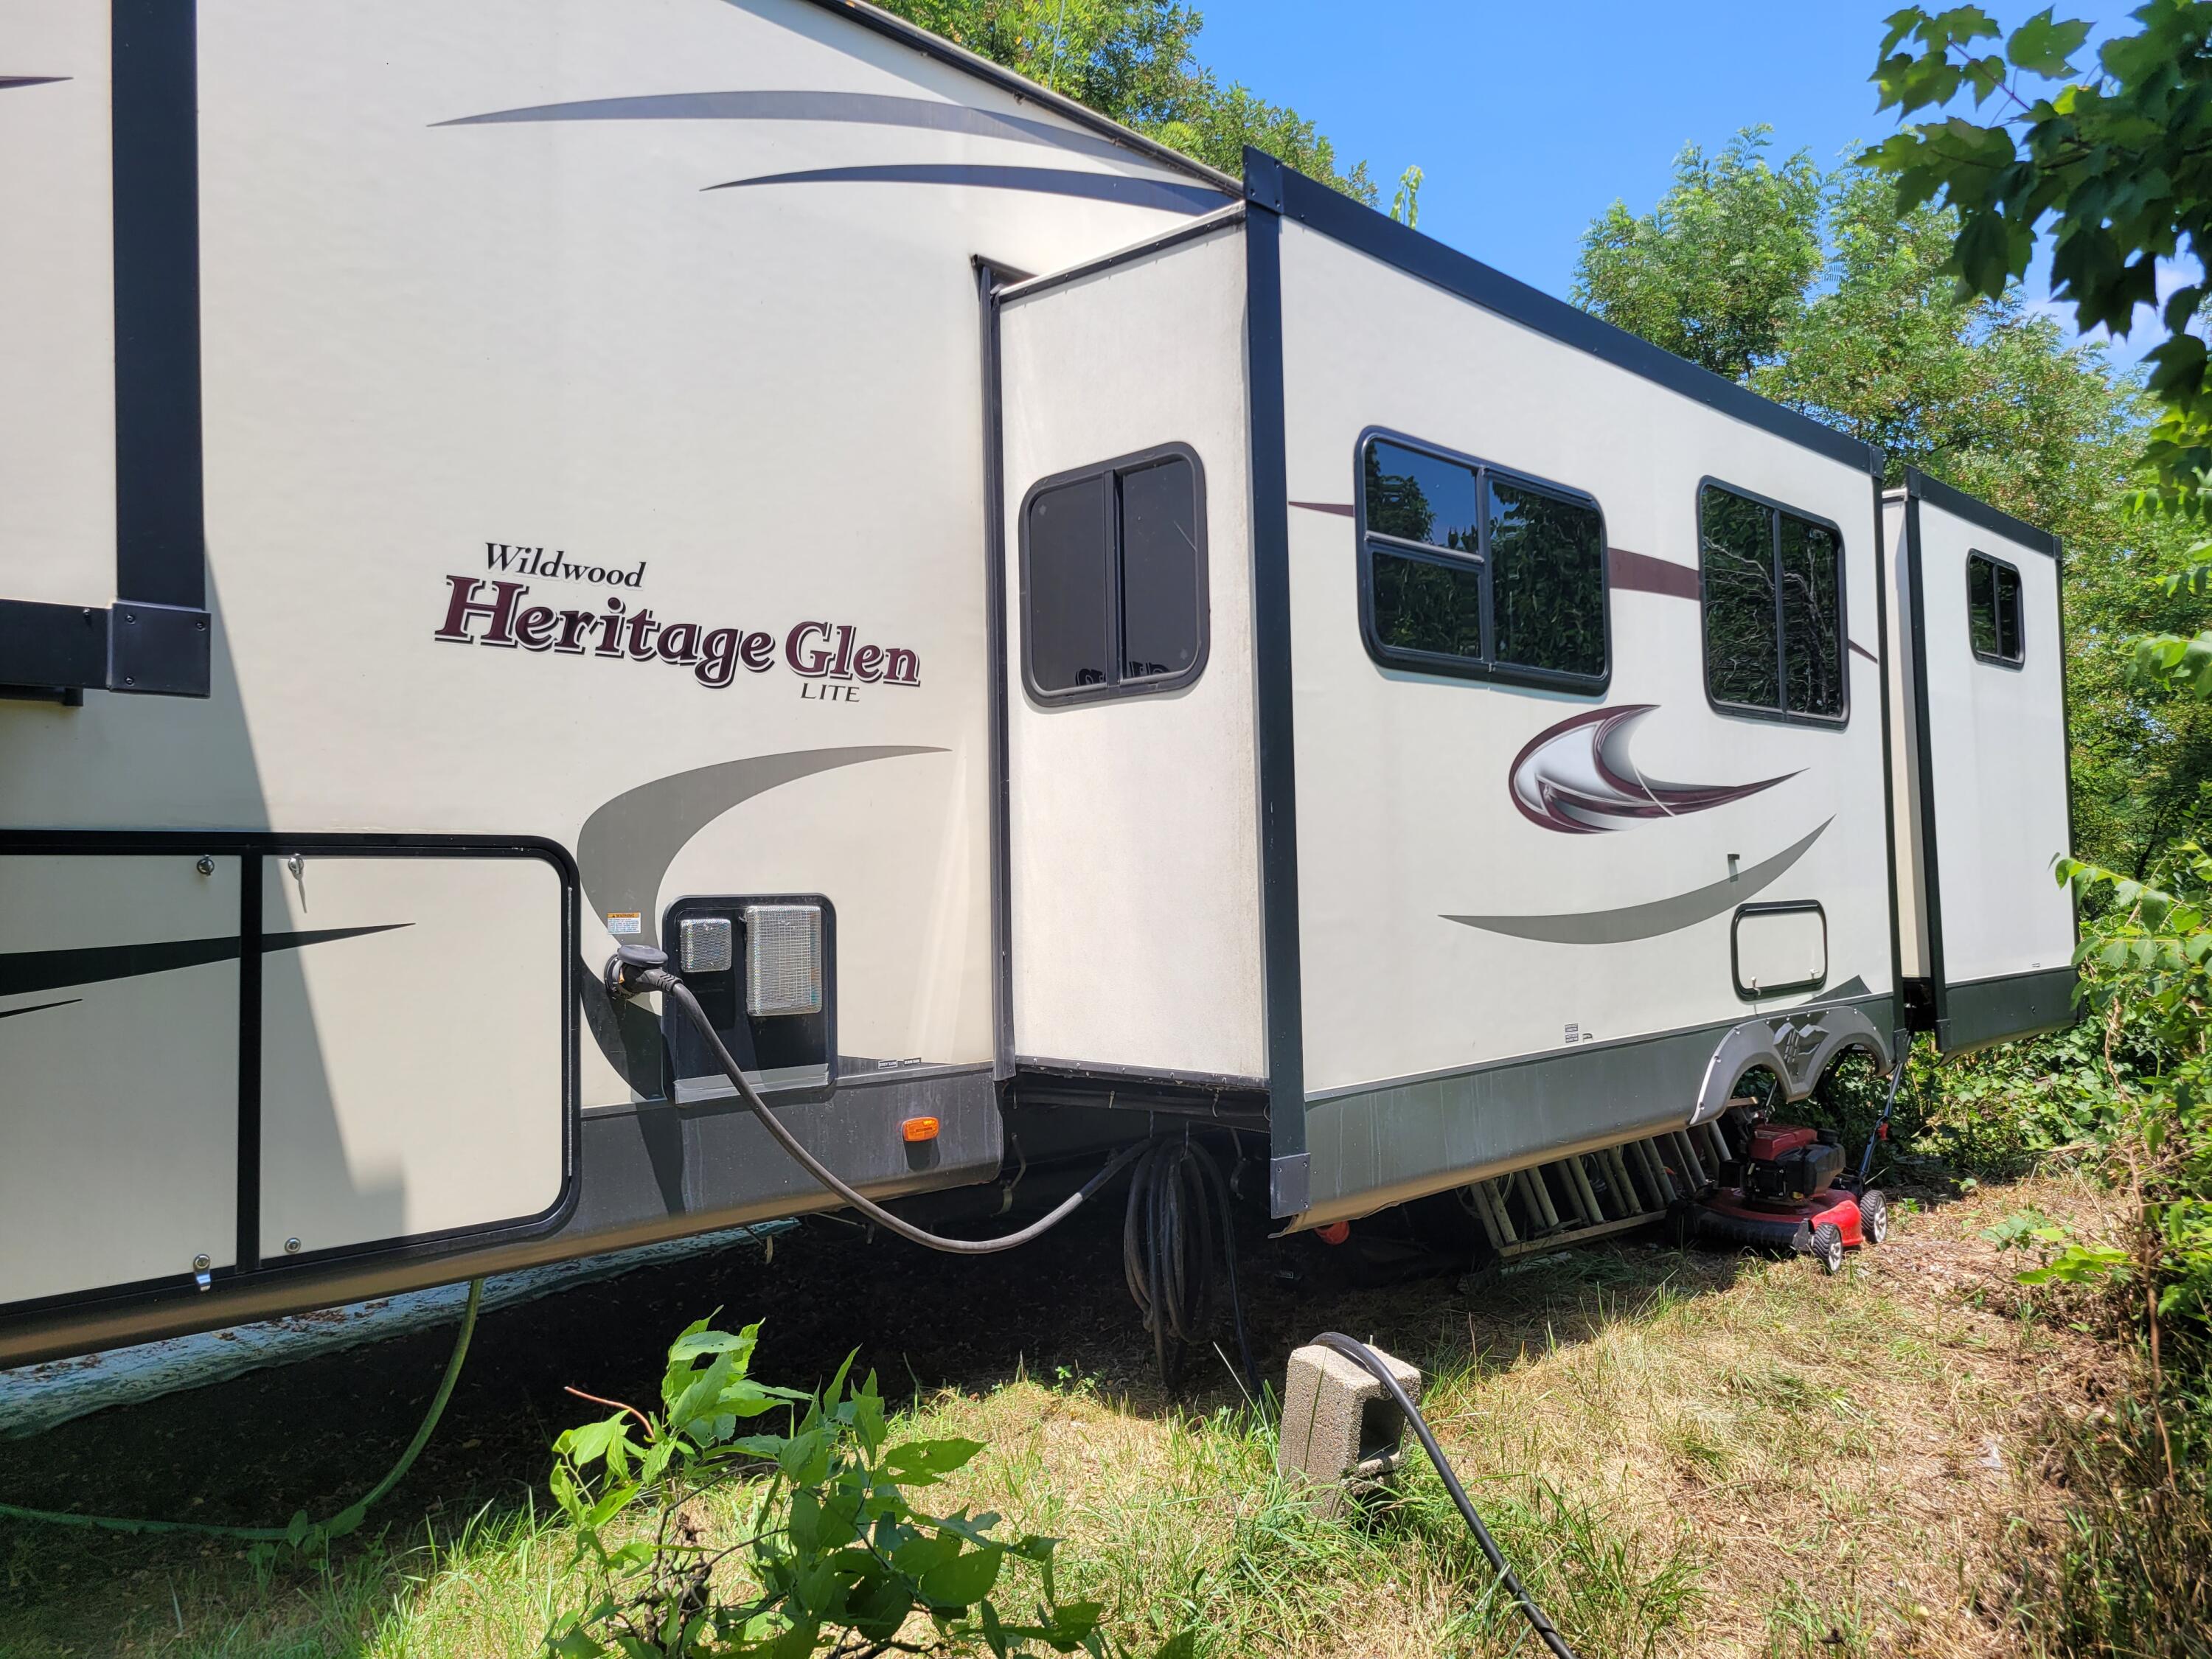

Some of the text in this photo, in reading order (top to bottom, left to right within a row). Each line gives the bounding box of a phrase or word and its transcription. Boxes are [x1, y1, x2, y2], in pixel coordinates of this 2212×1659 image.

[484, 542, 647, 588] Wildwood
[434, 574, 921, 689] Heritage Glen
[800, 683, 860, 702] LITE
